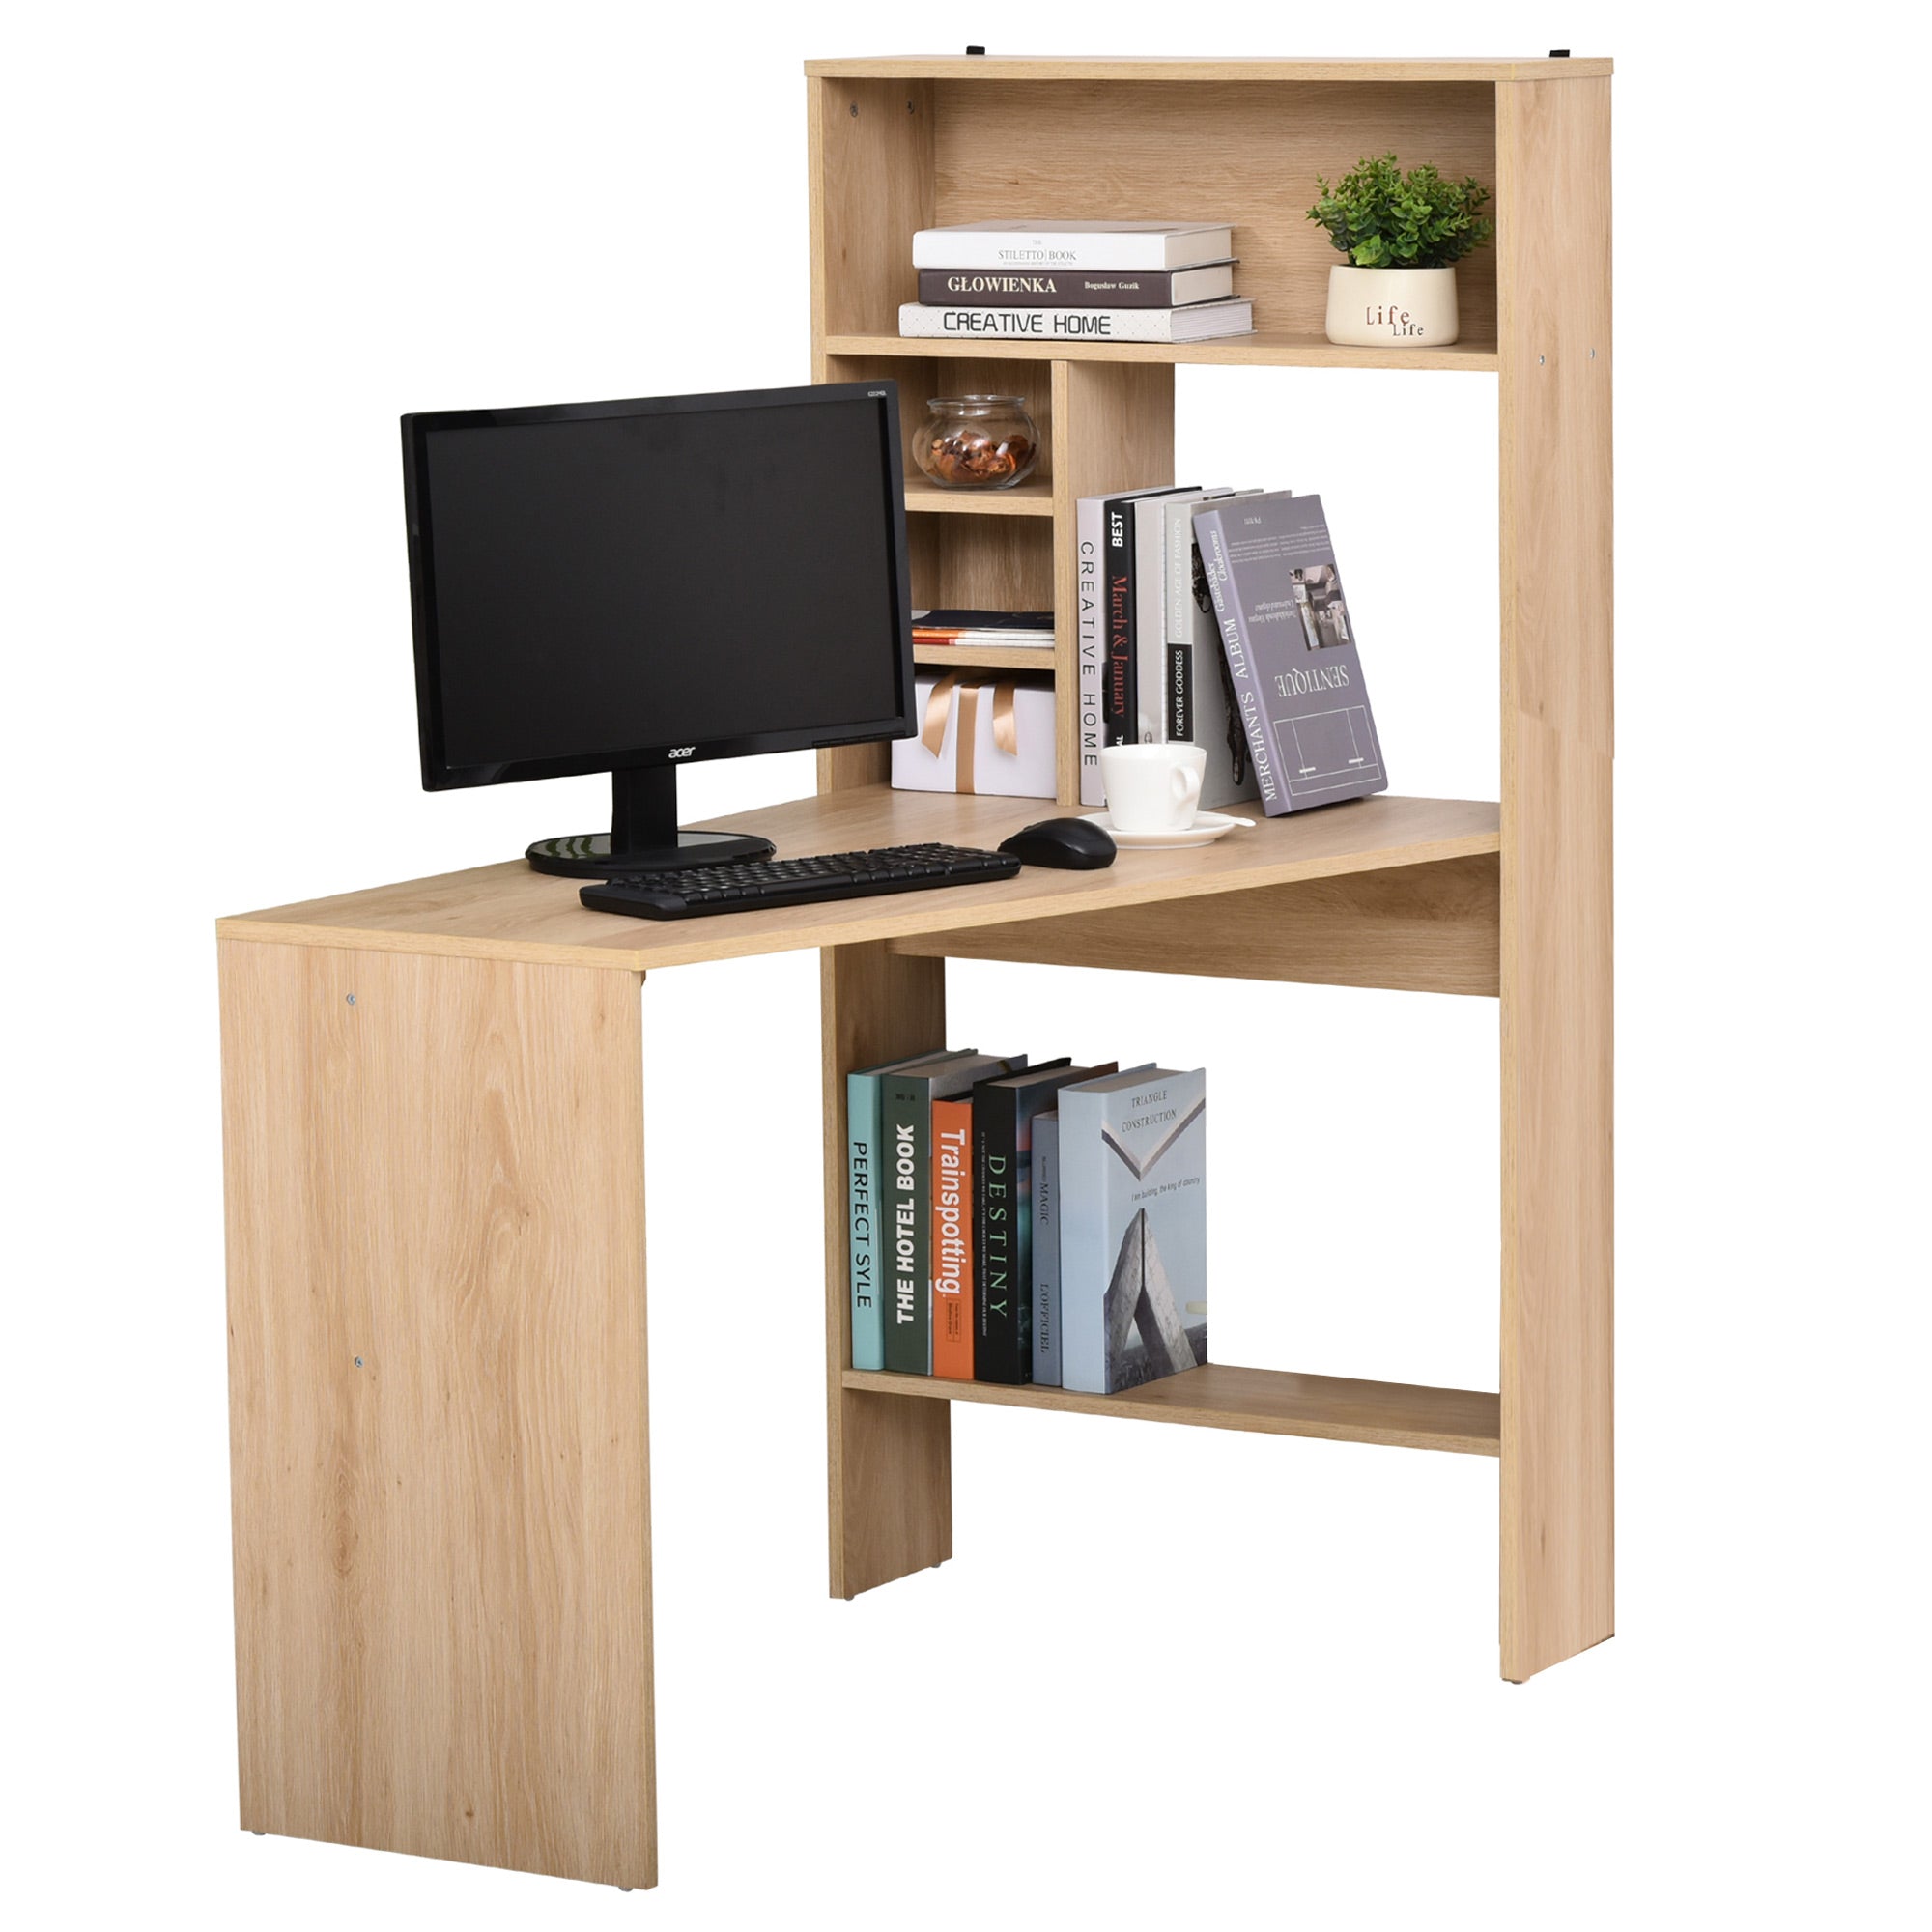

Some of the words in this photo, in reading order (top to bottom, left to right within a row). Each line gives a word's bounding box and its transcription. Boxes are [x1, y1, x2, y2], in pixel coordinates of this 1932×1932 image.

[998, 250, 1044, 261] STILETTO
[1049, 250, 1076, 261] BOOK
[943, 312, 1043, 333] CREATIVE
[1054, 314, 1111, 334] HOME
[1366, 305, 1410, 325] Life
[1393, 323, 1424, 336] Life
[1111, 511, 1123, 548] BEST
[1173, 517, 1181, 559] FASHION
[1080, 541, 1096, 675] CREATIVE
[1112, 576, 1128, 630] March
[1112, 634, 1128, 648] &
[1223, 618, 1249, 679] ALBUM
[1111, 650, 1129, 718] January
[1175, 649, 1184, 695] GODDESS
[1274, 664, 1350, 697] SENTIQUE
[1083, 693, 1097, 766] HOME
[1175, 696, 1184, 737] FOREVER
[668, 746, 696, 758] acer
[1240, 691, 1277, 802] MERCHANTS
[1122, 1108, 1177, 1133] CONSTRUCTION
[1131, 1090, 1168, 1109] TRIANGLE
[896, 1123, 915, 1191] BOOK
[853, 1142, 870, 1247] PERFECT
[1039, 1182, 1050, 1226] MAGIC
[896, 1198, 915, 1273] HOTEL
[988, 1154, 1008, 1318] DESTINY
[856, 1253, 872, 1308] SYLE
[896, 1278, 915, 1325] THE
